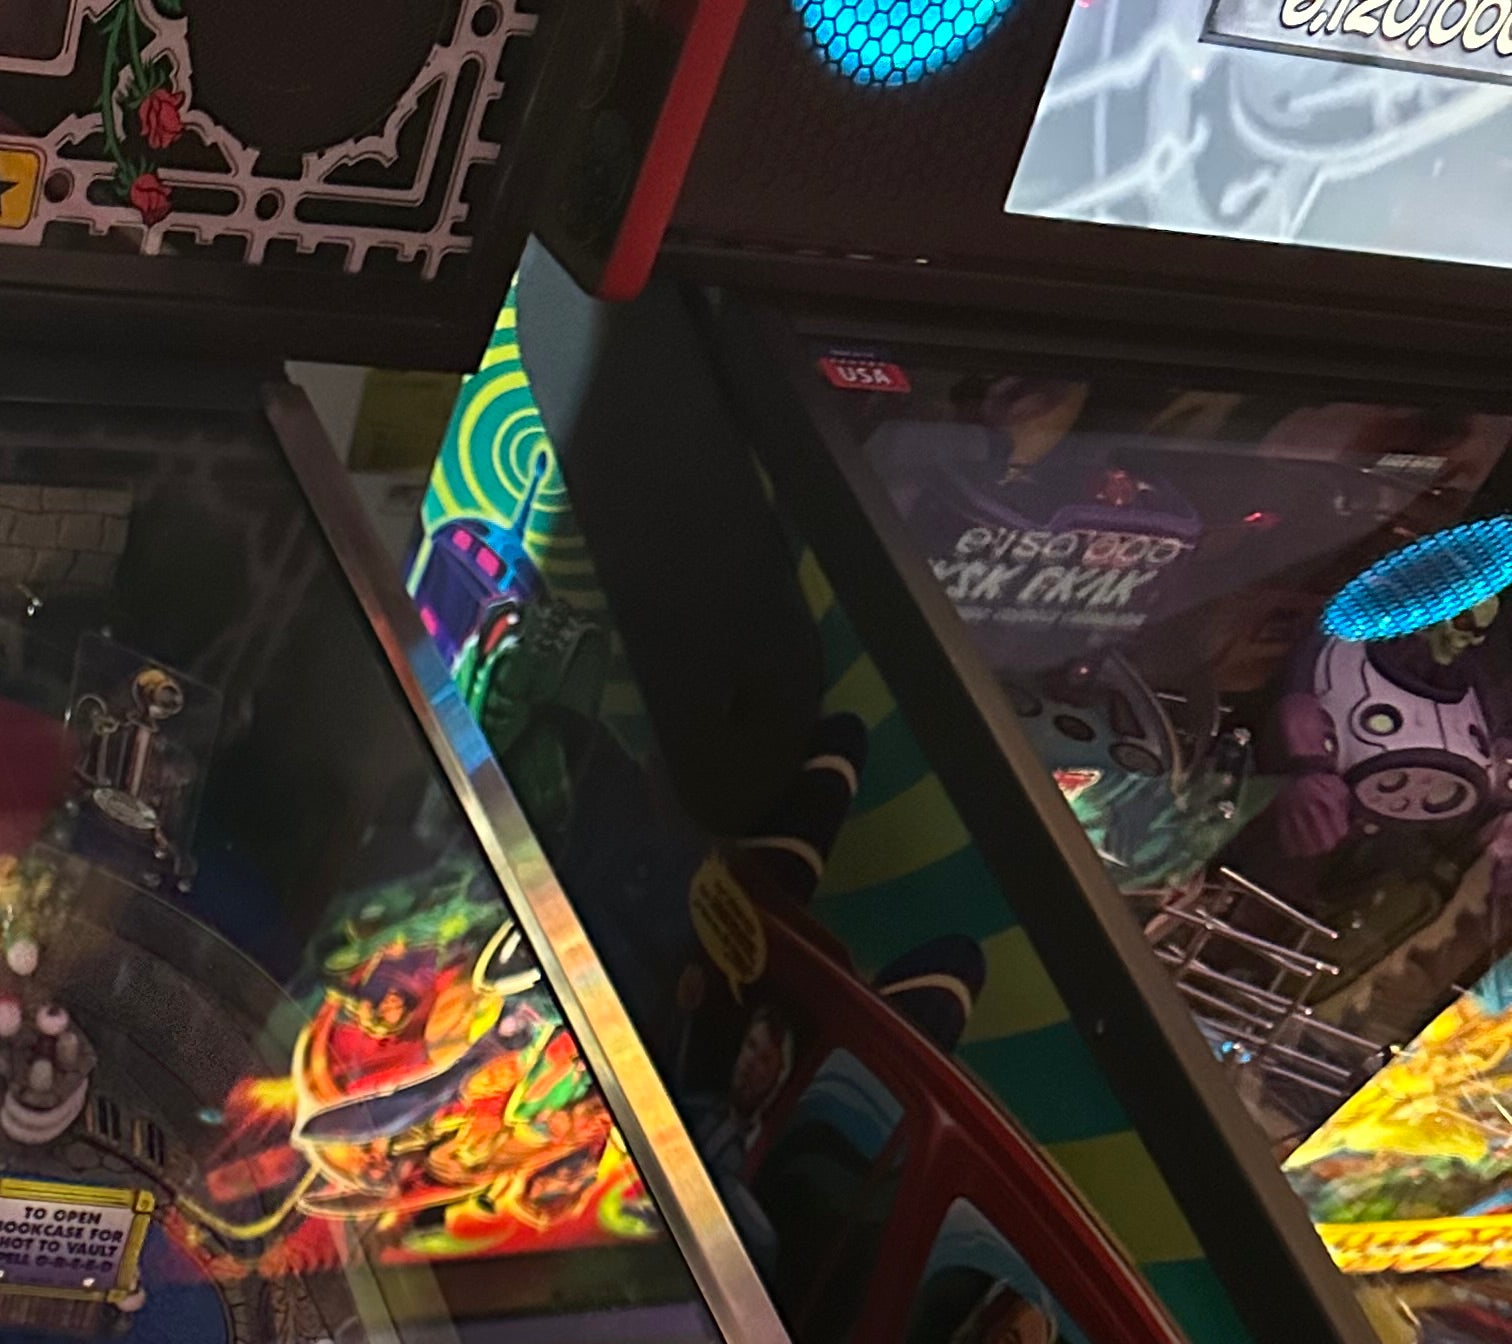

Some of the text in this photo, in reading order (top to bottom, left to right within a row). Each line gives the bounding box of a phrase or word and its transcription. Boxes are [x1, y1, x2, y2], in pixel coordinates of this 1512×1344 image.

[837, 367, 890, 385] USA
[24, 1206, 101, 1225] TO OPEN
[89, 1228, 123, 1242] FOR
[38, 1239, 60, 1252] TO
[66, 1241, 117, 1257] VAULT
